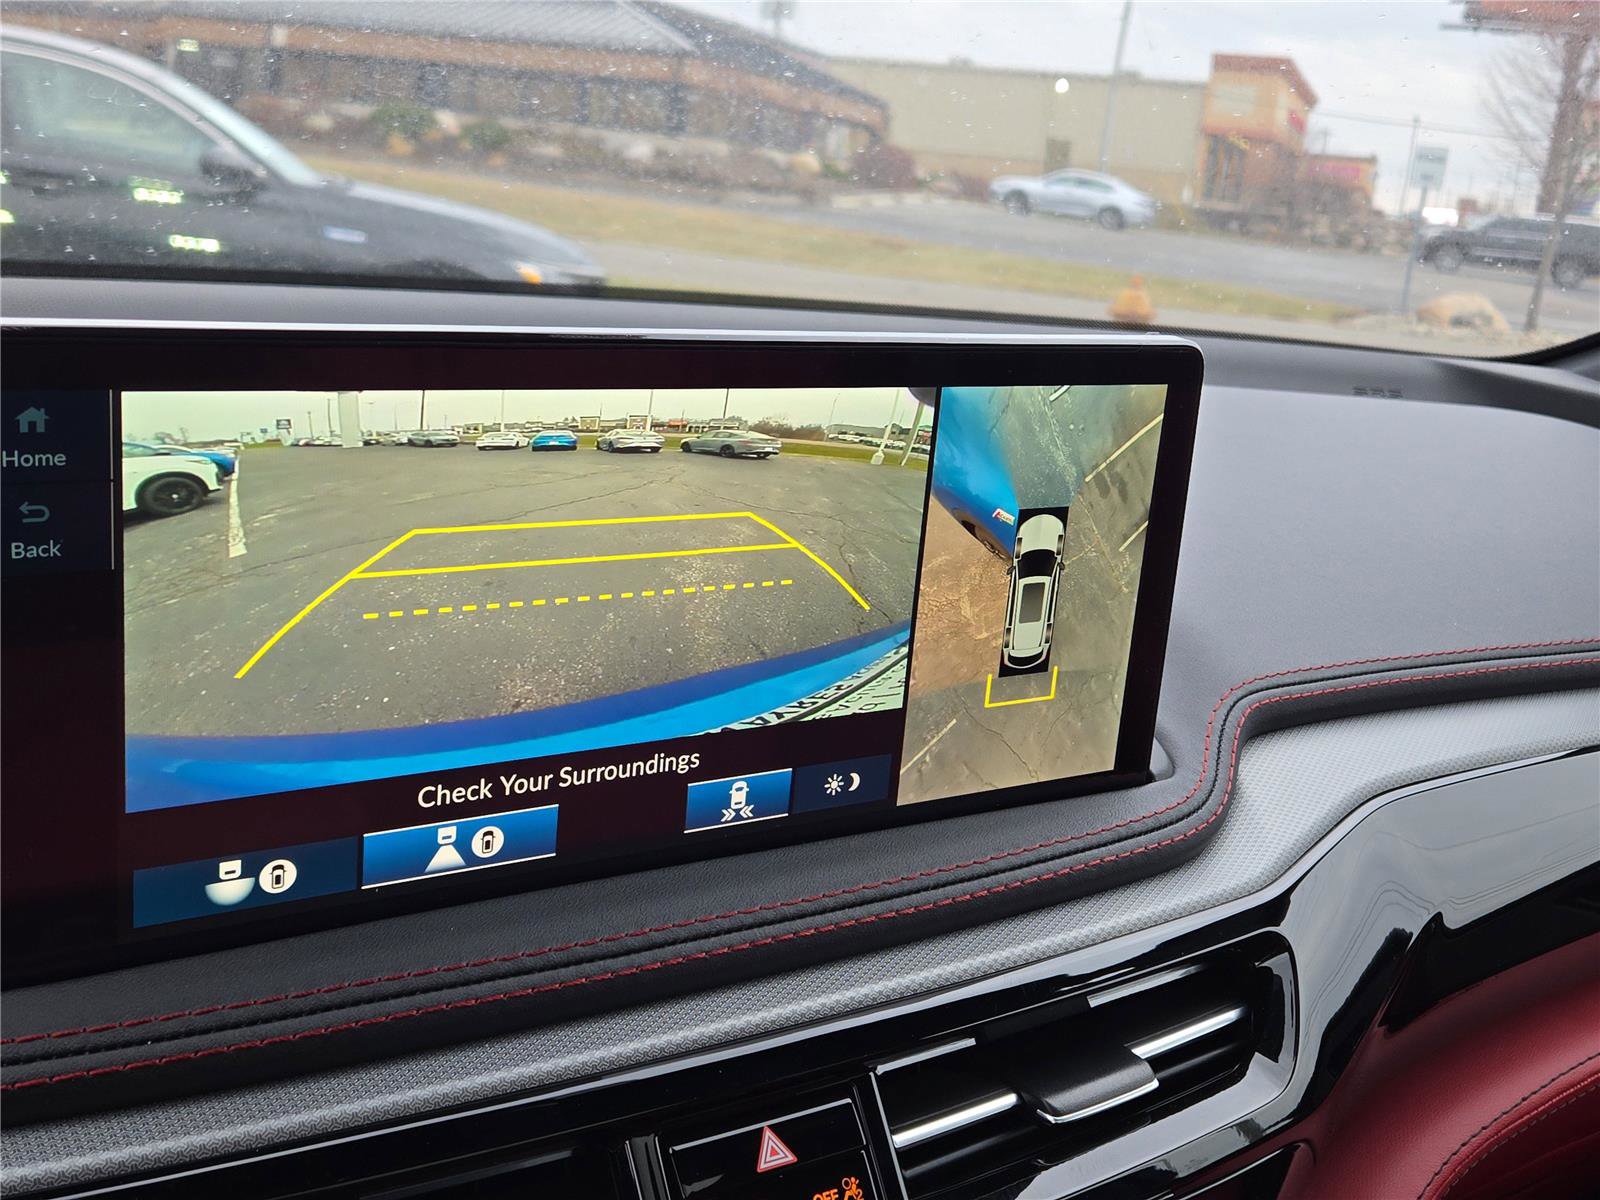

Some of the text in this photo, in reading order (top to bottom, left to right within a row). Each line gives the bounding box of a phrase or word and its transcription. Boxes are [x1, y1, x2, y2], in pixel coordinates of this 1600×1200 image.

[2, 450, 67, 468] Home
[11, 539, 62, 559] Back
[417, 752, 701, 808] Check Your Surroundings
[813, 1188, 839, 1200] OFF
